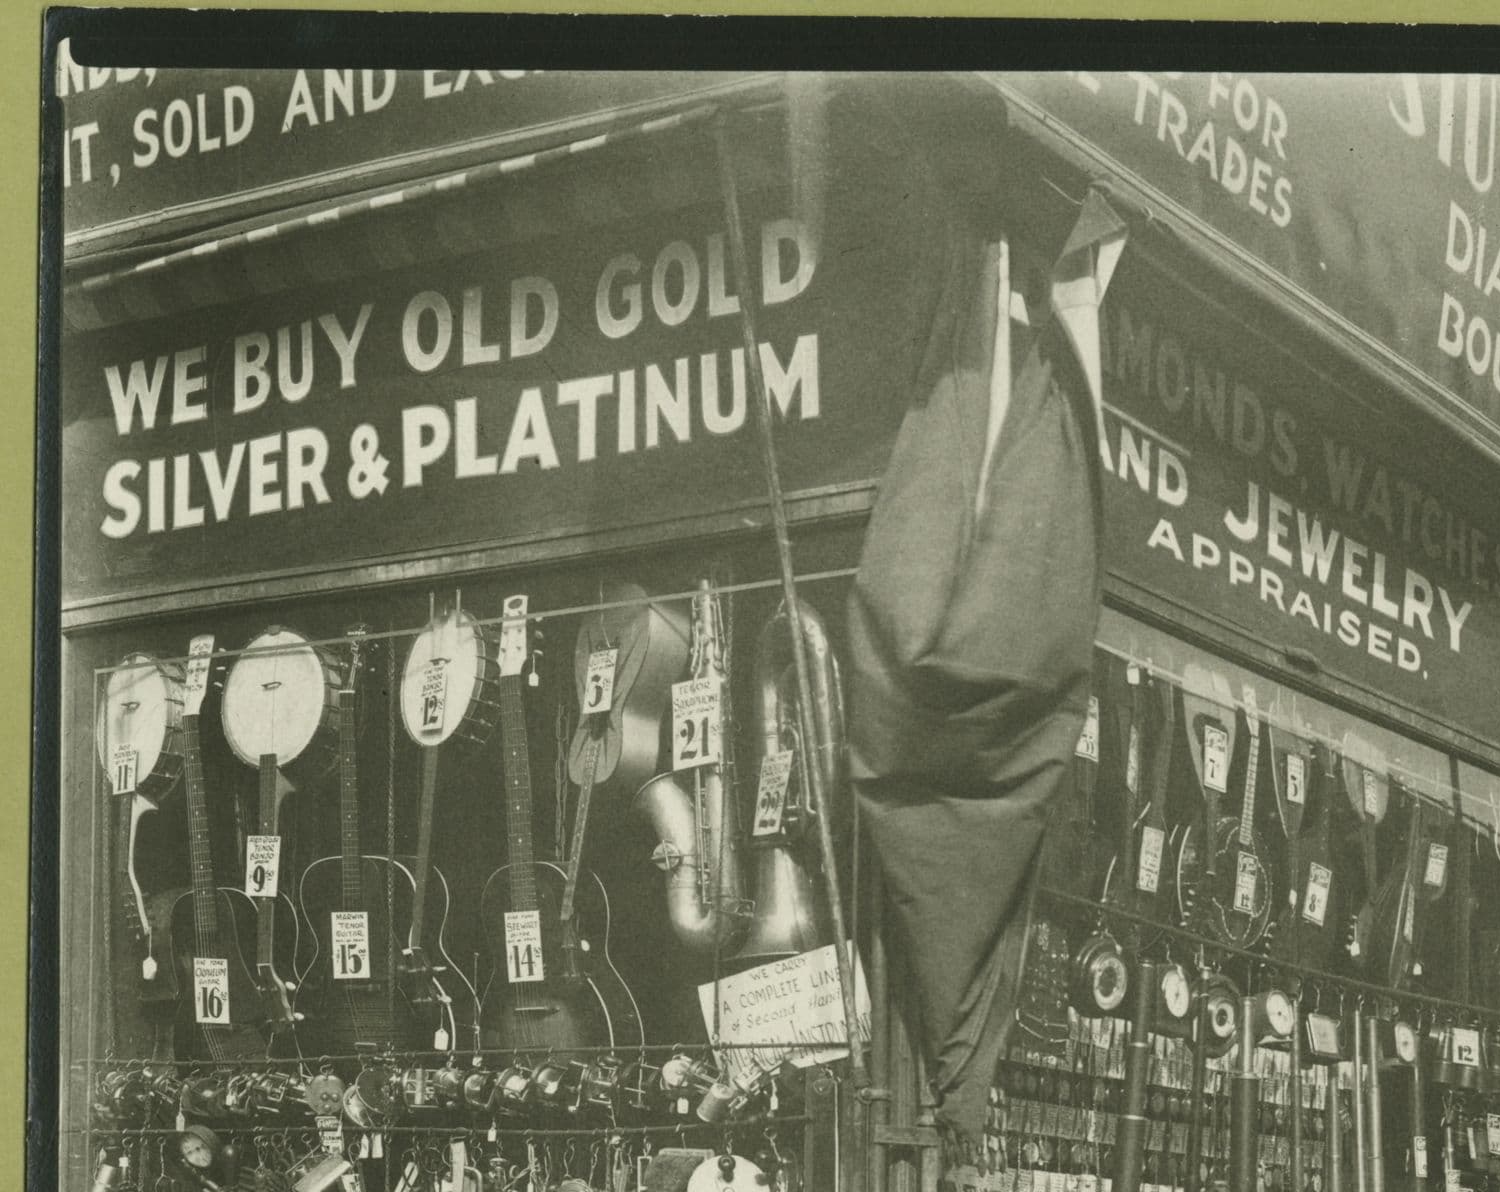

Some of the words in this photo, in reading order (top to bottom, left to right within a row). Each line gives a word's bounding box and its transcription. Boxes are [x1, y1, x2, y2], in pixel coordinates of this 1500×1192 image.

[133, 86, 254, 168] SOLD
[281, 69, 396, 133] AND
[1132, 75, 1292, 227] TRADES
[1208, 74, 1288, 159] FOR
[105, 346, 208, 434] WE
[233, 304, 374, 415] BUY
[403, 276, 560, 373] OLD
[596, 219, 818, 339] GOLD
[101, 423, 329, 539] SILVER
[348, 423, 390, 500] &
[403, 334, 820, 487] PLATINUM
[1147, 519, 1428, 680] APPRAISED.
[1224, 481, 1473, 652] JEWELRY
[739, 978, 801, 1009] COMPLETE
[751, 968, 768, 981] WE
[1457, 1045, 1474, 1062] 12
